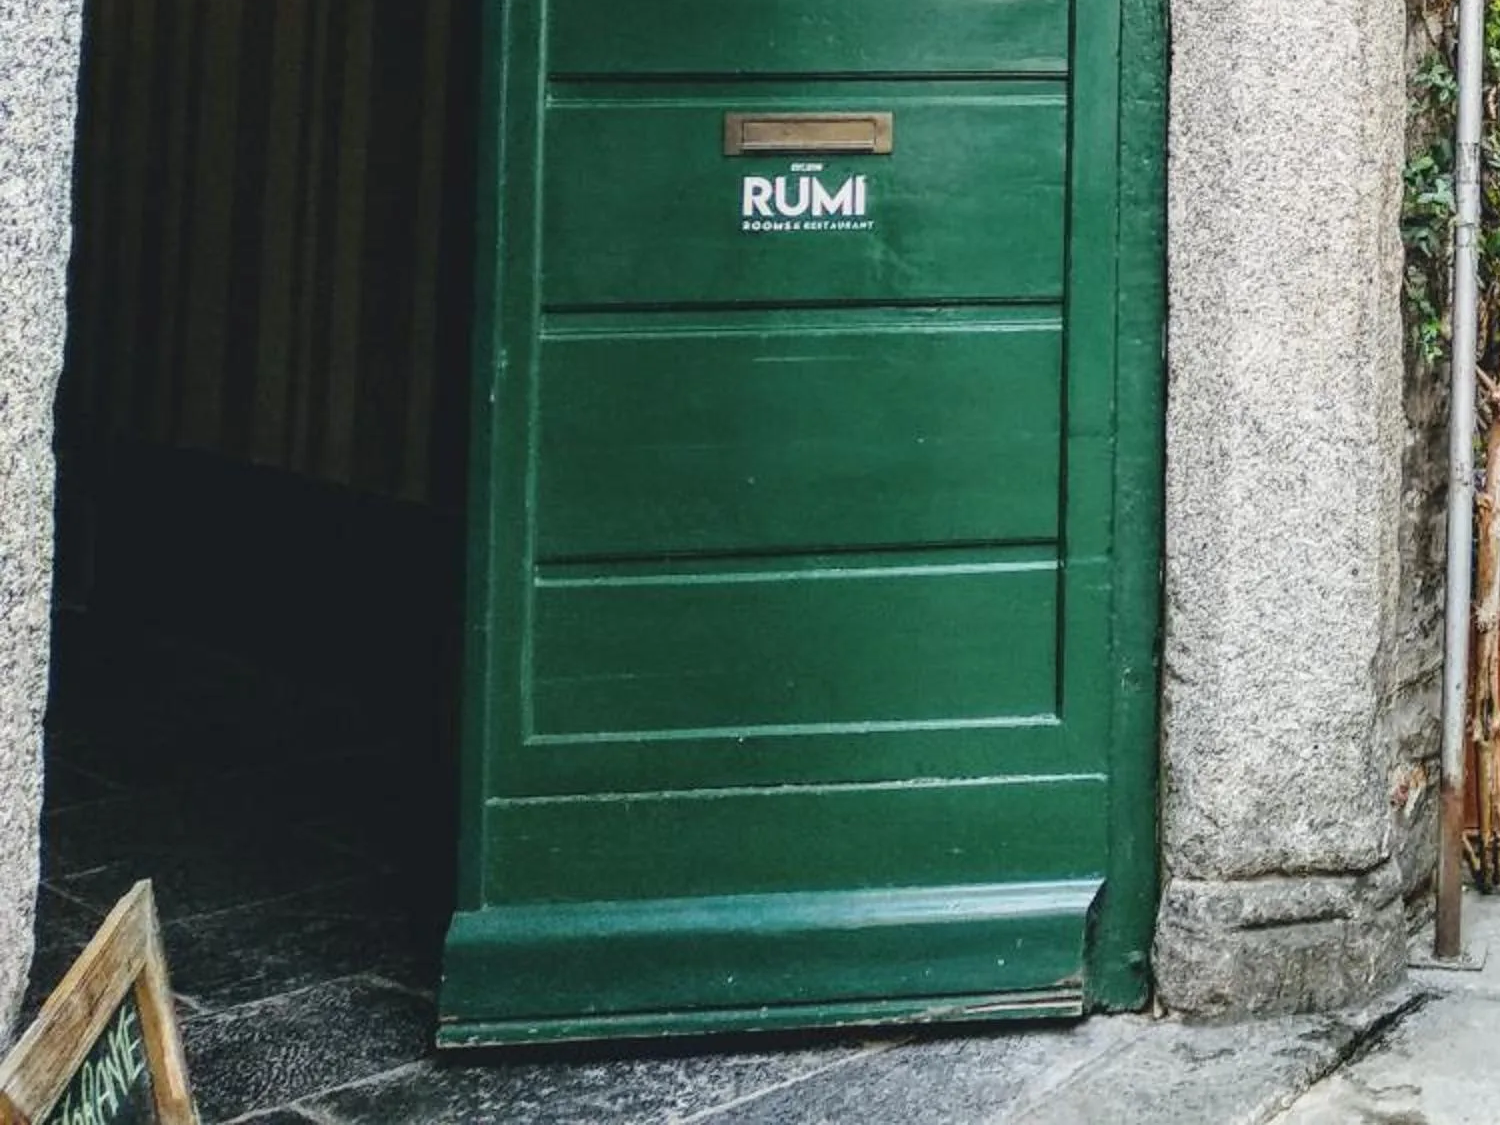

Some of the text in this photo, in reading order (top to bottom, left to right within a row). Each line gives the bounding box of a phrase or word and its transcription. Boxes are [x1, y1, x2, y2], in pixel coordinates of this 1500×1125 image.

[743, 176, 866, 216] RUMI
[742, 221, 791, 231] ROOMS
[803, 220, 875, 230] RESTAURANT
